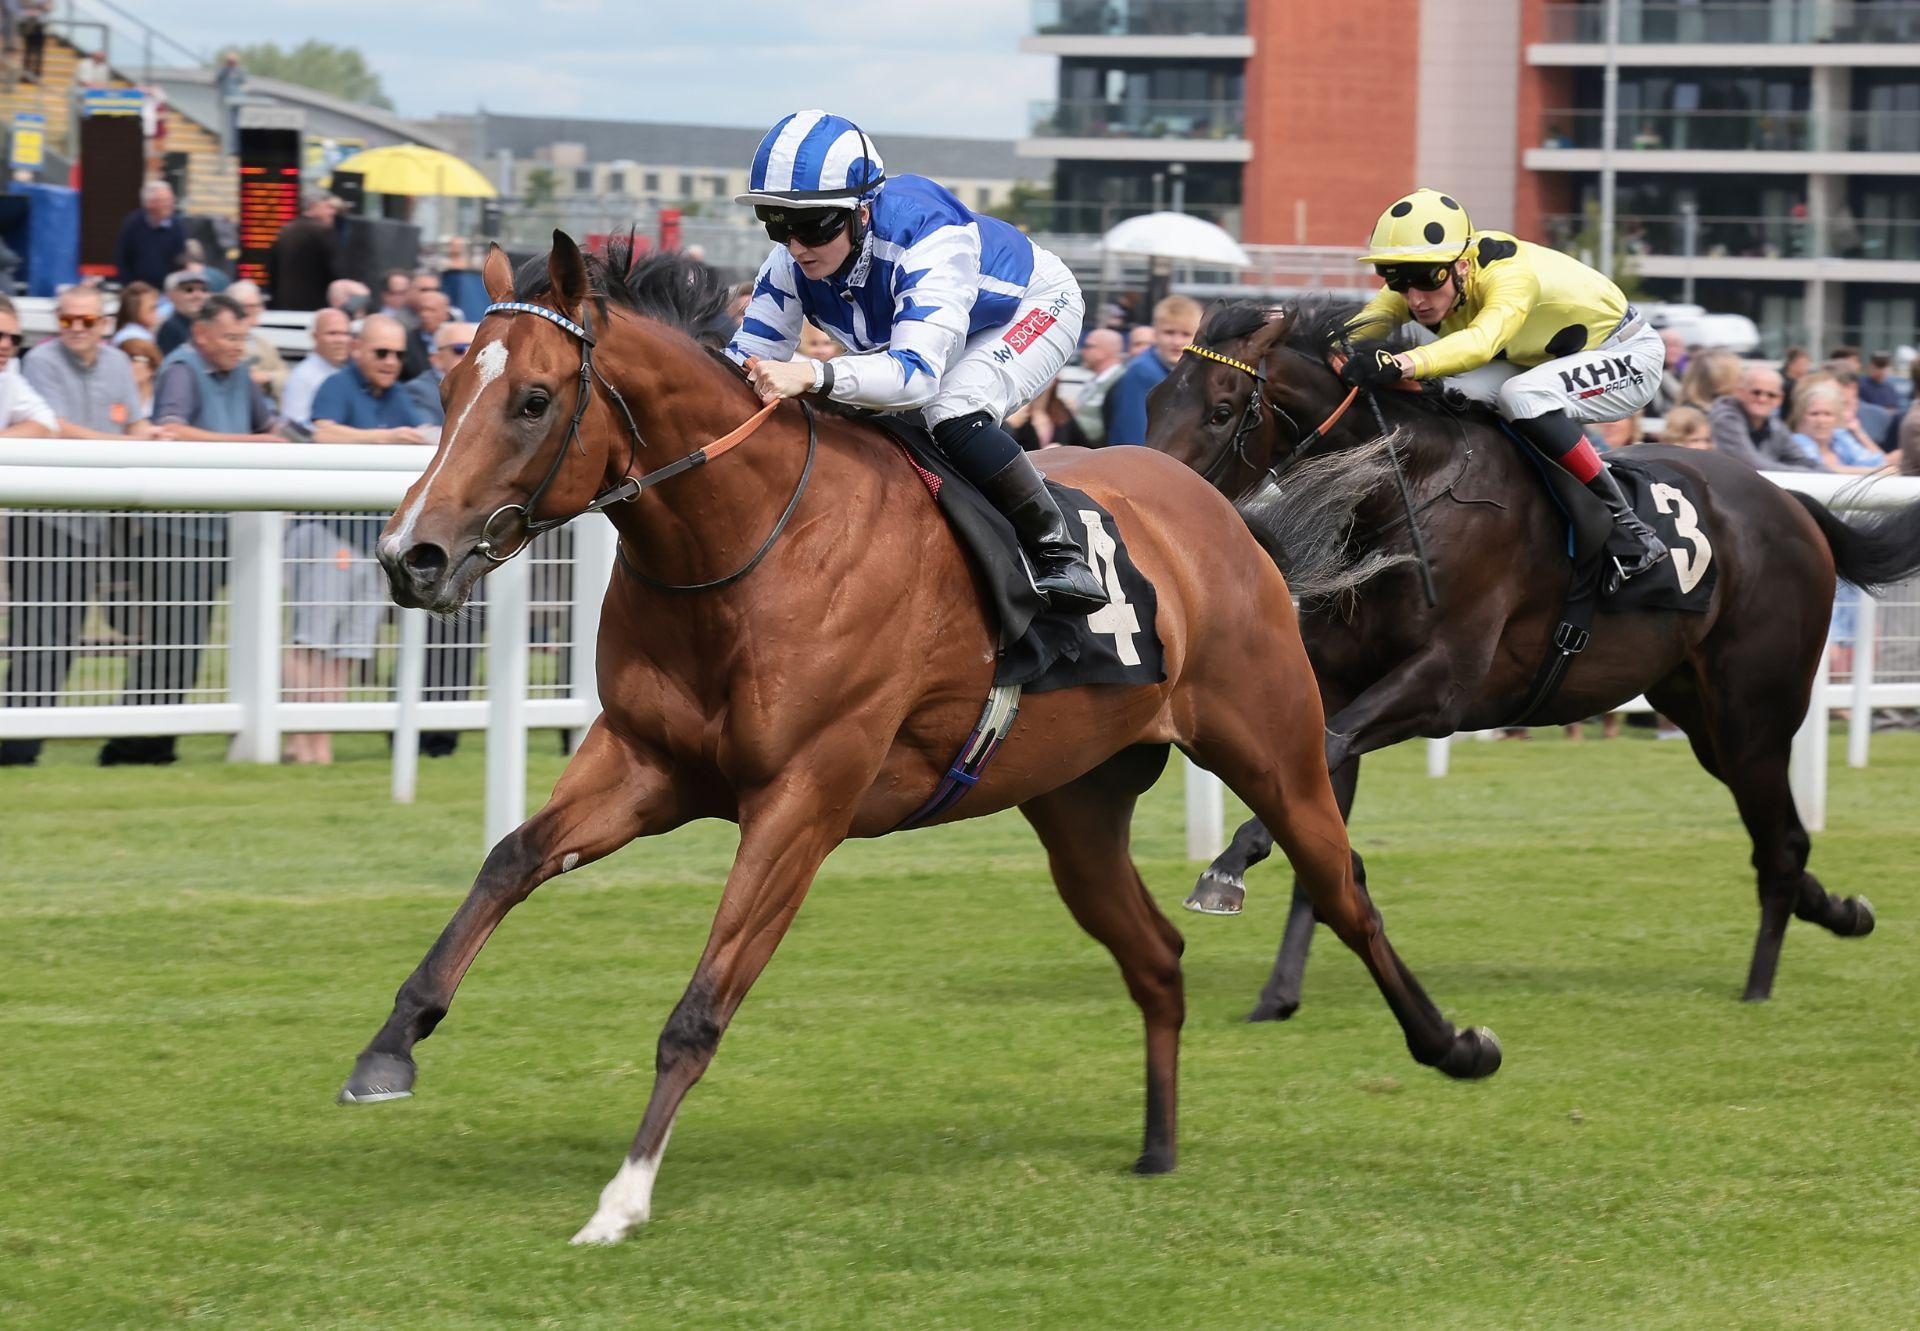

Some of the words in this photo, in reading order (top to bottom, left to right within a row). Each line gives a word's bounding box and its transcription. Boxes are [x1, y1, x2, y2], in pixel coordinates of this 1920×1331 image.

[993, 345, 1014, 365] sky
[1010, 309, 1051, 348] sports
[1558, 355, 1643, 393] KHK
[1605, 375, 1644, 393] RACING
[1650, 483, 1712, 594] 3
[1078, 509, 1142, 666] 4
